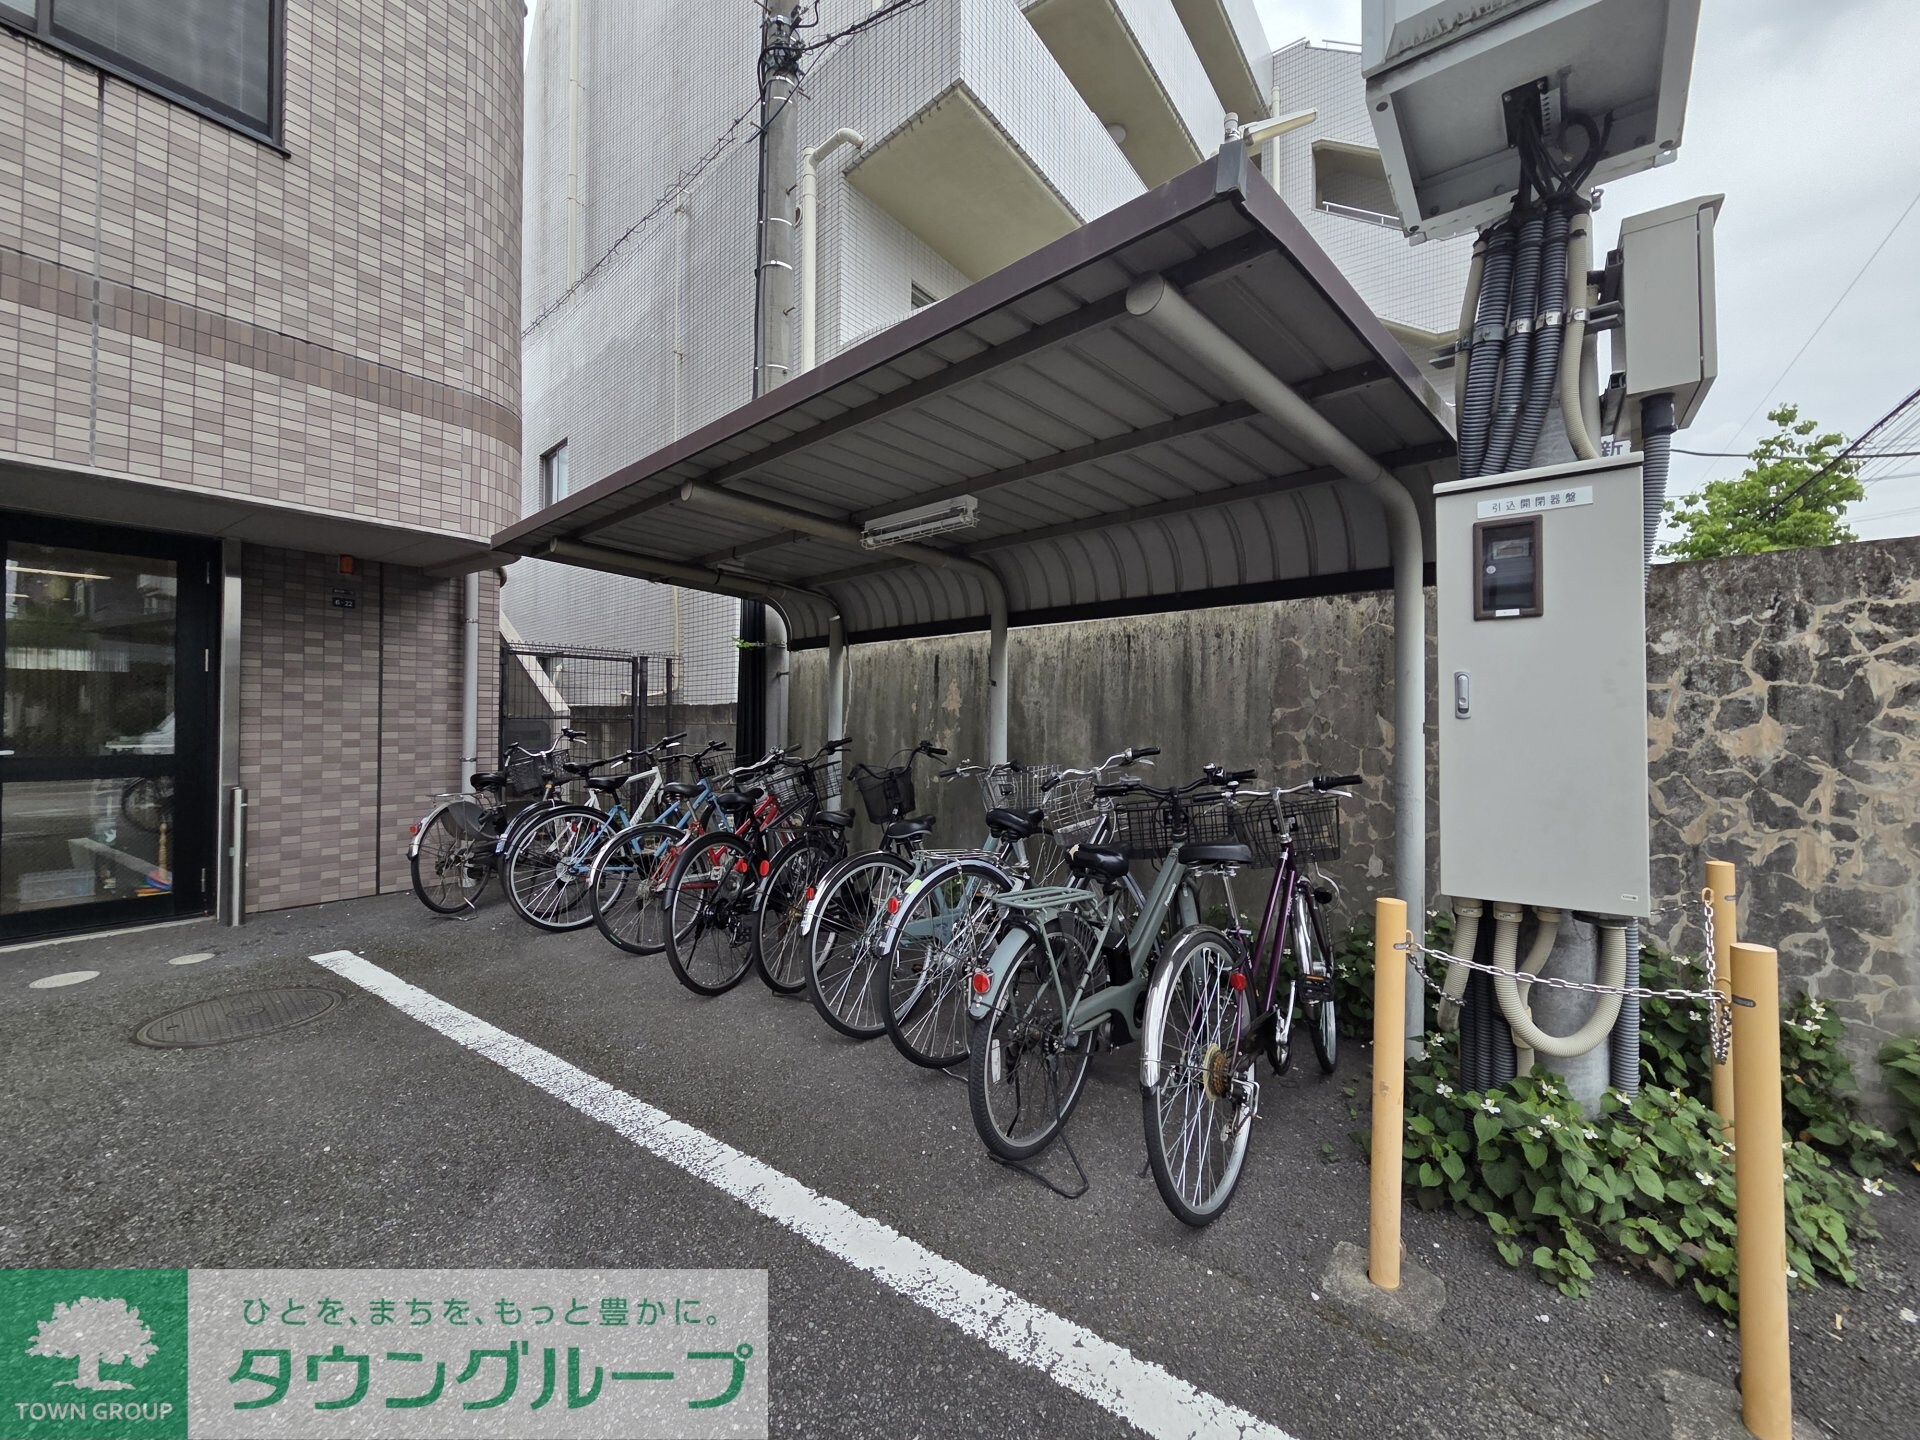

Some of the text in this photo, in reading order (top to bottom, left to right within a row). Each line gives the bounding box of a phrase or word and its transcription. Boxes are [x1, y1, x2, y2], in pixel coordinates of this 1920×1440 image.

[1492, 492, 1576, 513] 引込開閉器盤
